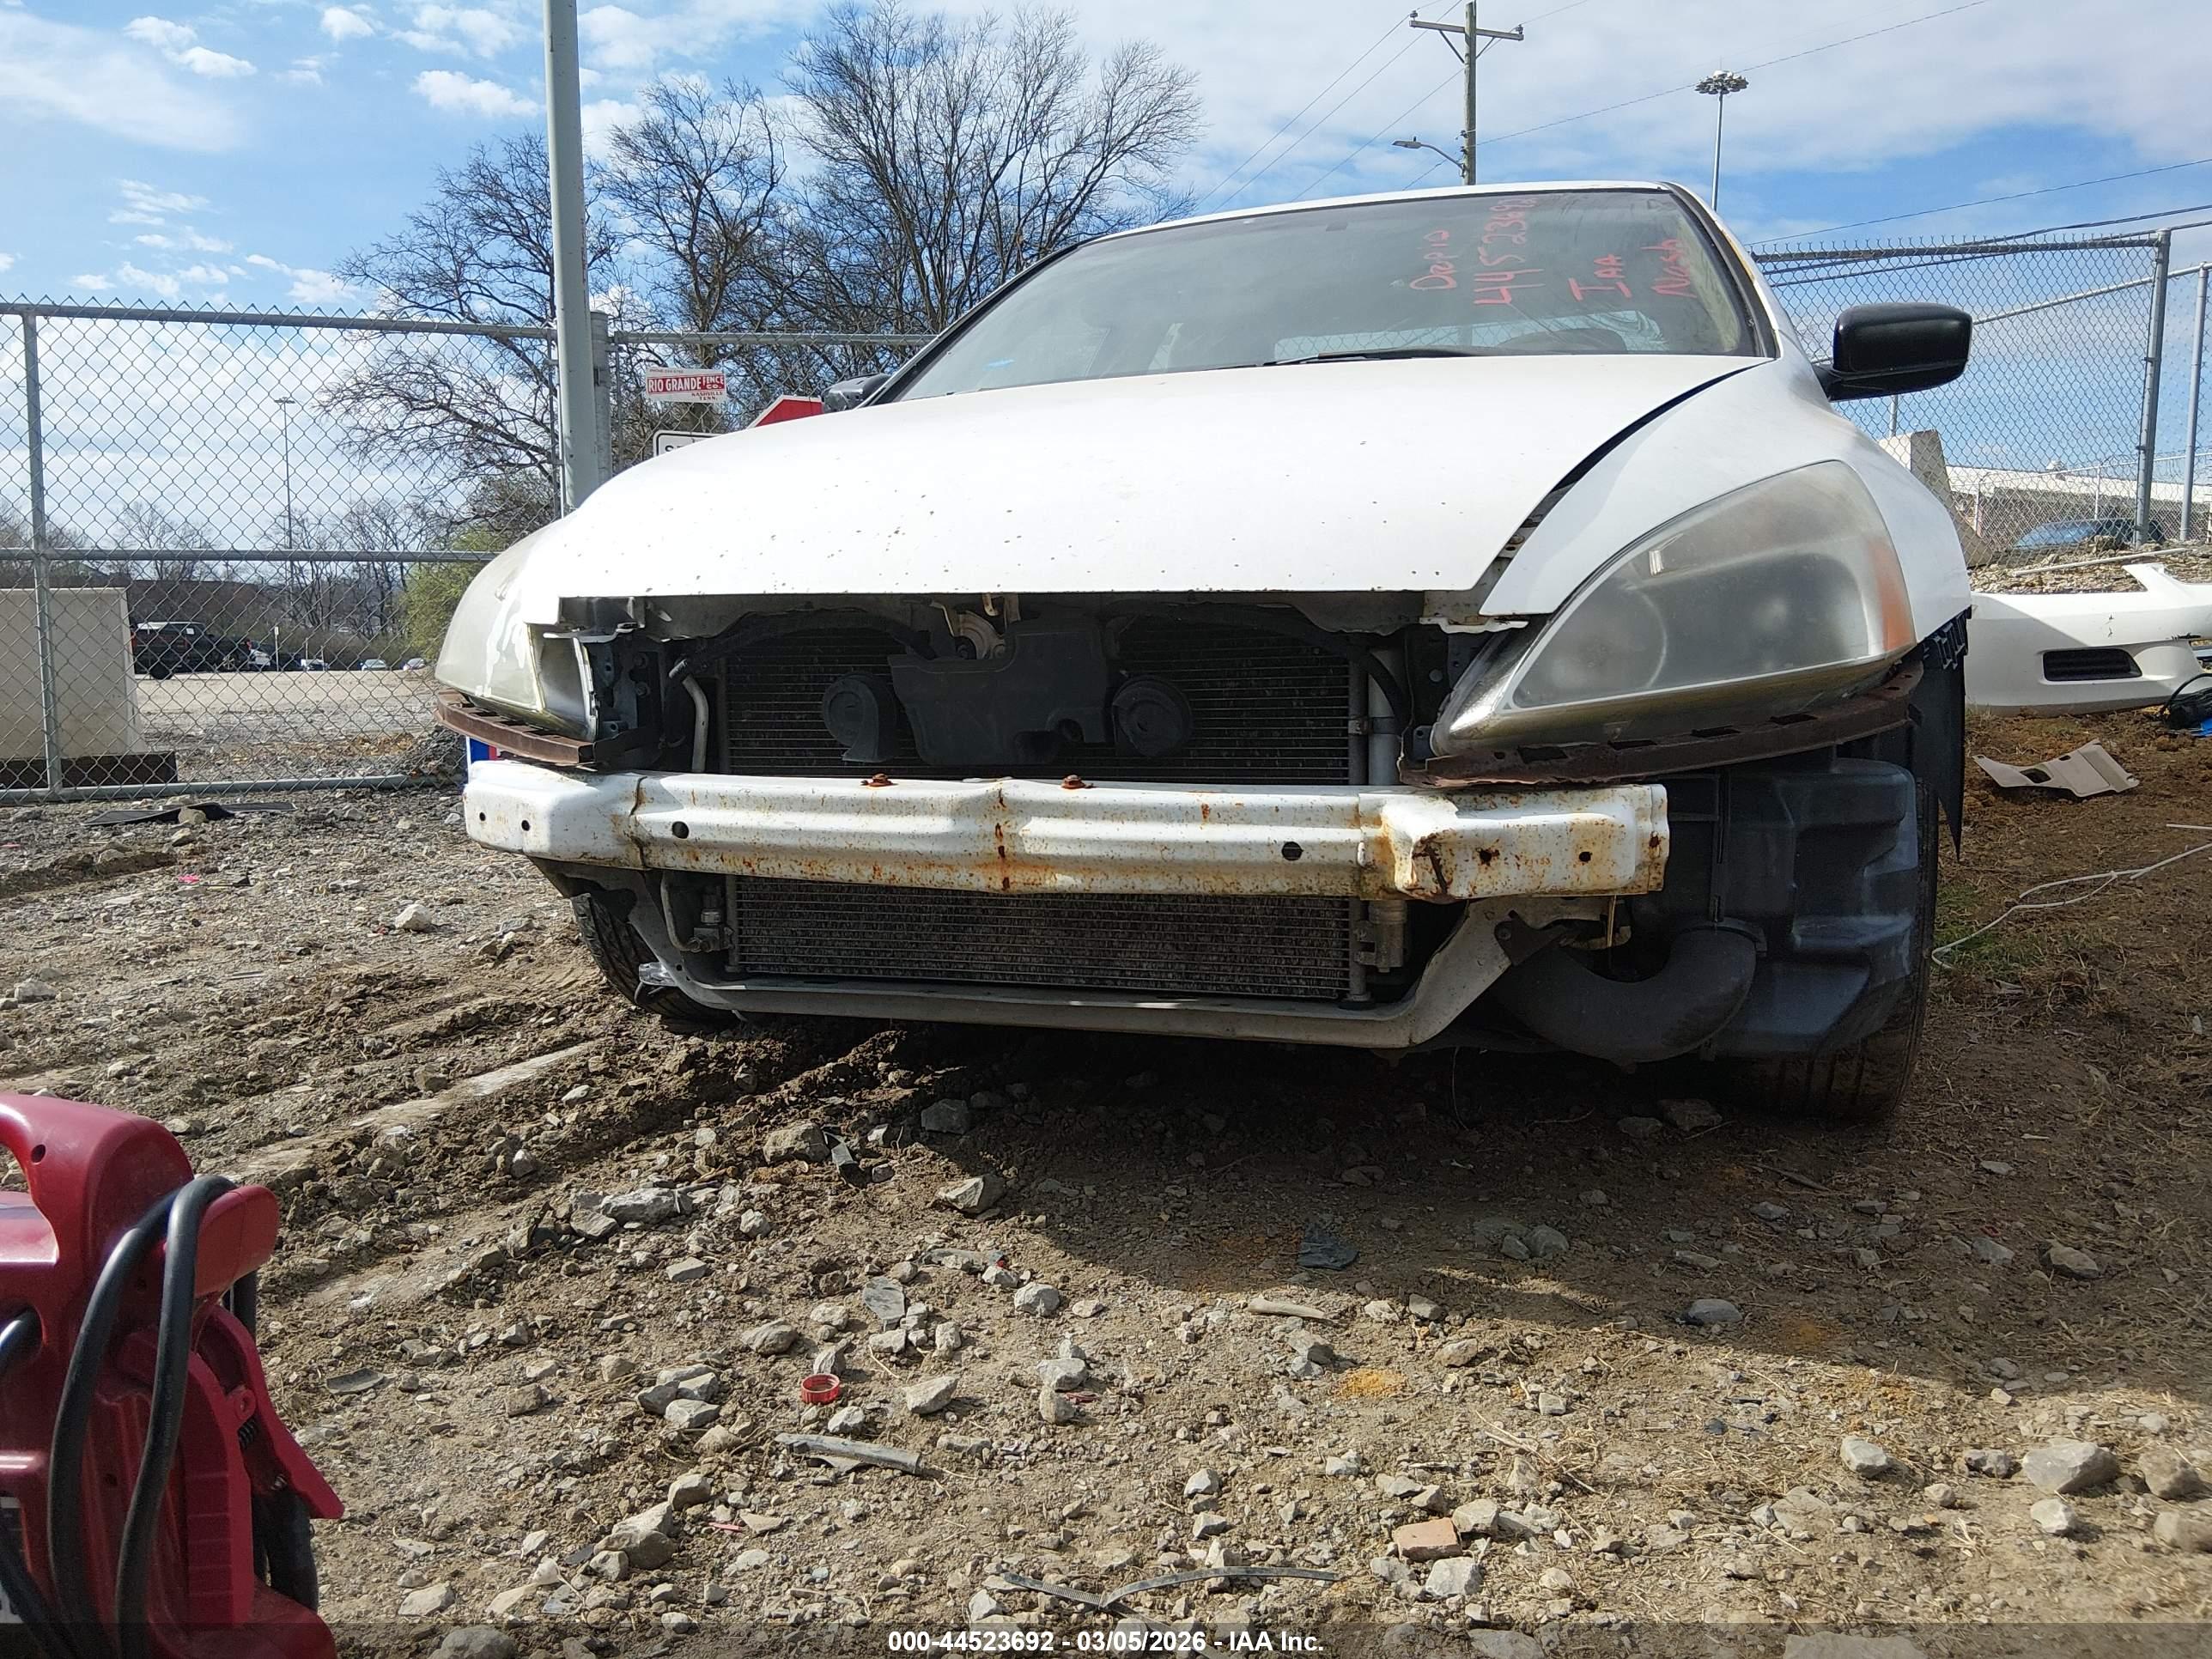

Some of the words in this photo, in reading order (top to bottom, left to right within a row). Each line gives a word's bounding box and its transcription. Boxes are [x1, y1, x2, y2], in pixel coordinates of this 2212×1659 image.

[648, 379, 664, 392] RIO
[665, 377, 702, 391] GRANDE
[702, 375, 724, 386] FENCE
